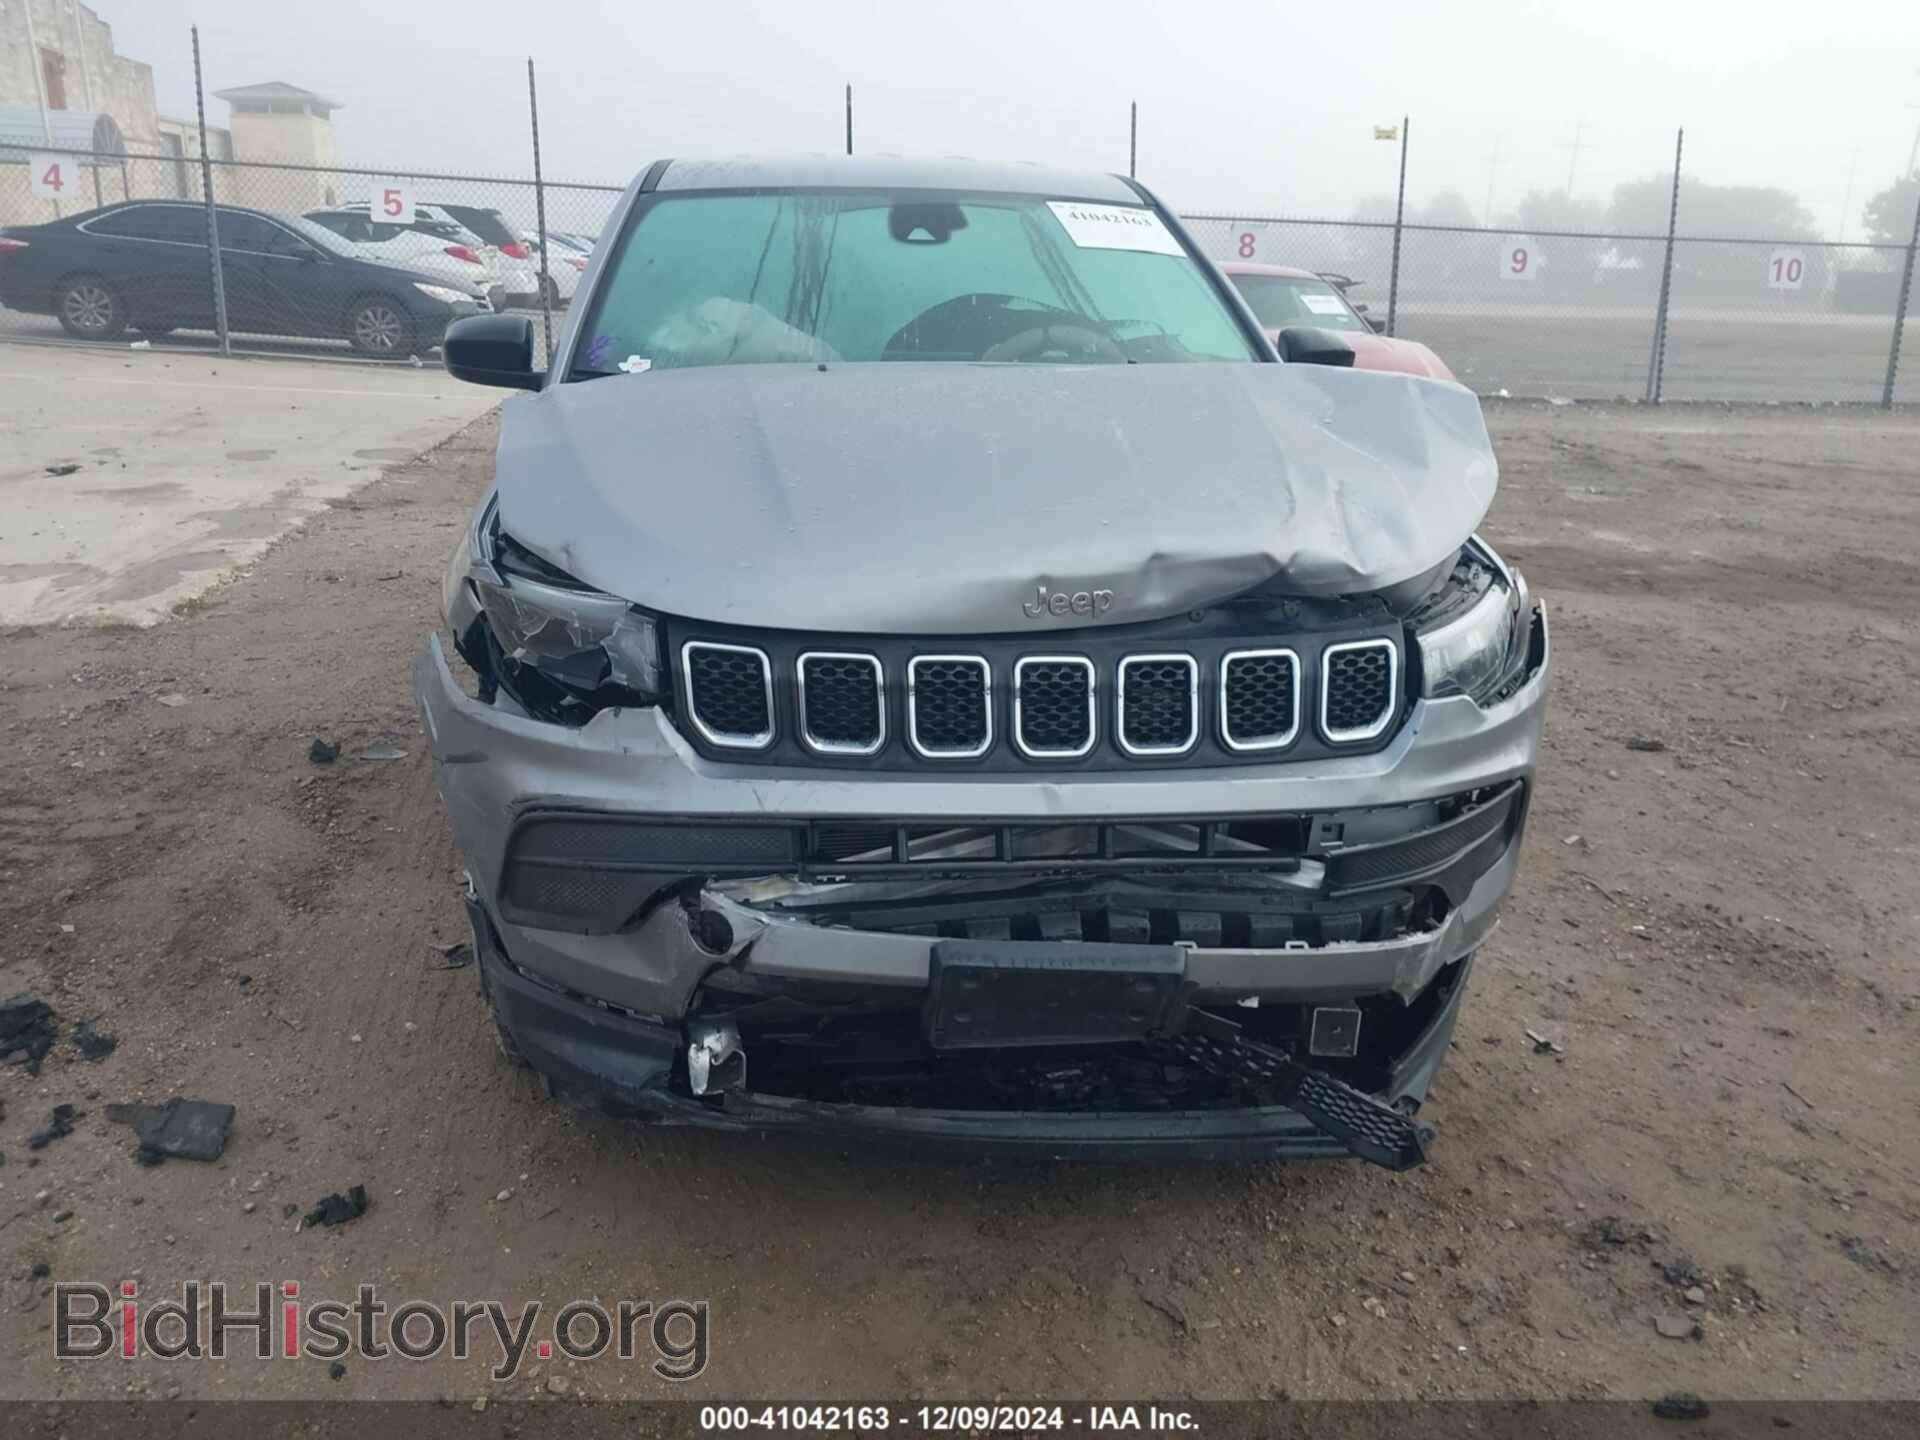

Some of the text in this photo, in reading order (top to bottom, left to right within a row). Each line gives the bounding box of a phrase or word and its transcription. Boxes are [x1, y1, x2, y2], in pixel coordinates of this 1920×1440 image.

[42, 163, 64, 191] 4
[383, 189, 402, 216] 5
[1238, 233, 1256, 258] 8
[1510, 248, 1528, 273] 9
[1773, 258, 1802, 282] 10
[1023, 586, 1114, 619] Jeep
